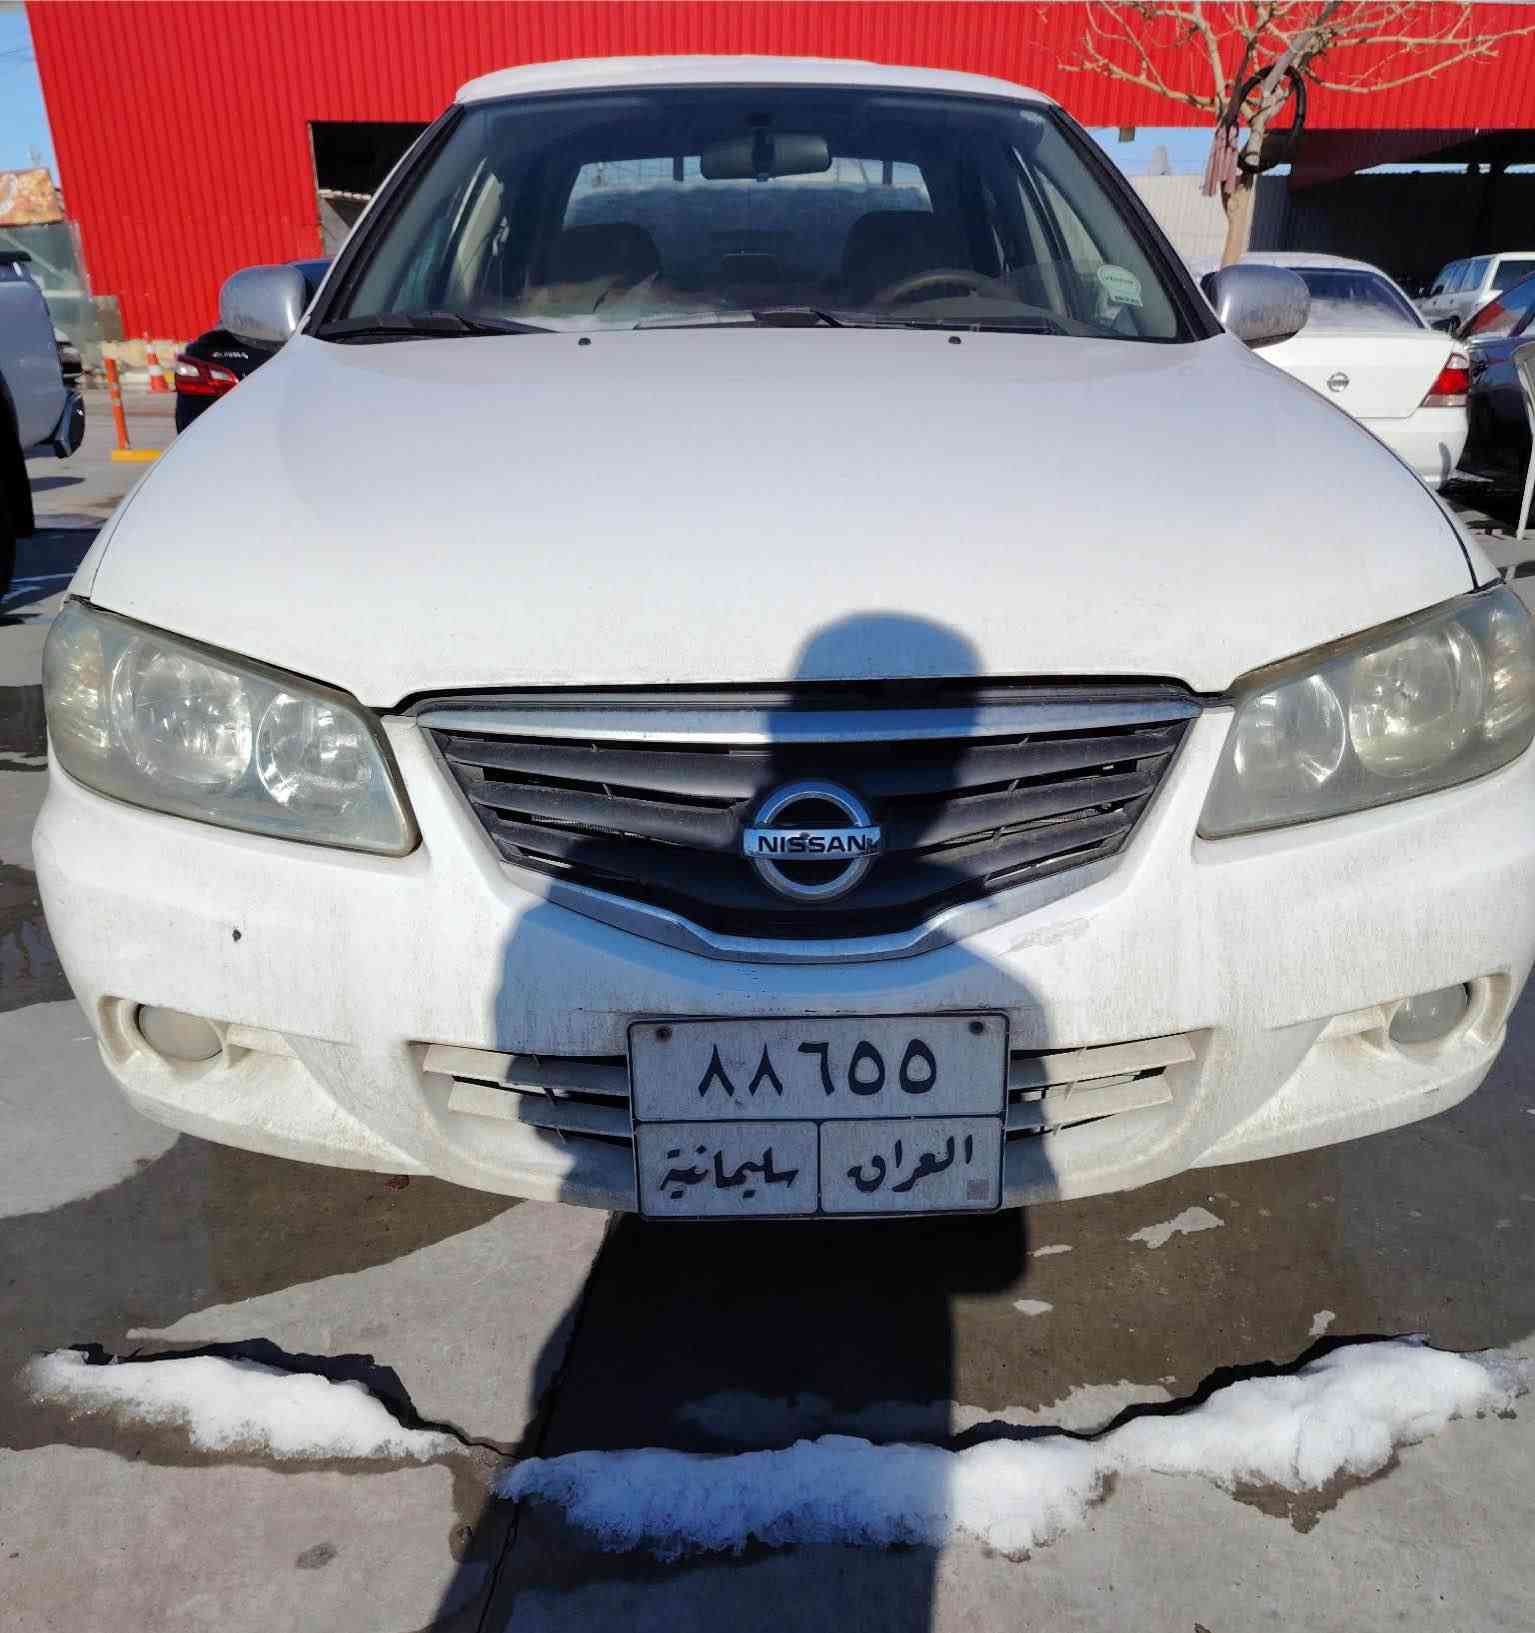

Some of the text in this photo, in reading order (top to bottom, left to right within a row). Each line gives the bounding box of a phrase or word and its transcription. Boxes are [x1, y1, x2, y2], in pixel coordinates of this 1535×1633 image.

[758, 835, 866, 853] NISSAN
[698, 1038, 937, 1097] ٨٨٦٥٥
[660, 1144, 799, 1199] سليمانية
